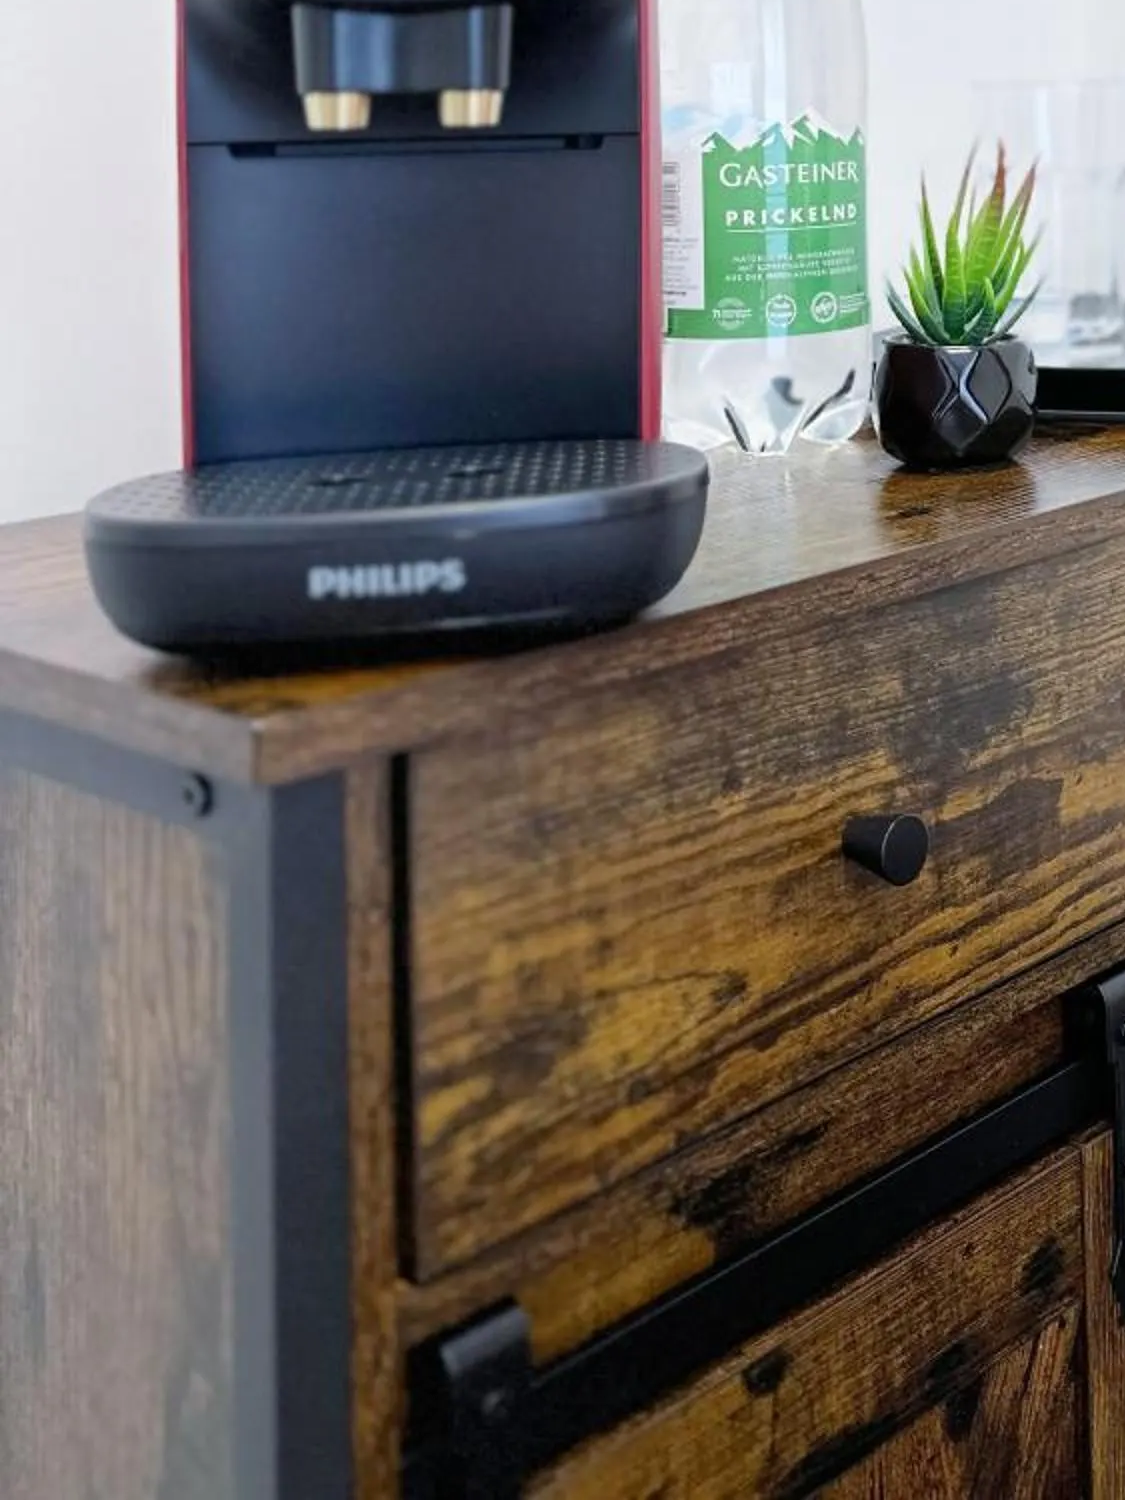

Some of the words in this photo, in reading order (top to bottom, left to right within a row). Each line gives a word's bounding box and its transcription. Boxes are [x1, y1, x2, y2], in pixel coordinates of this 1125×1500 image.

[719, 161, 860, 188] GASTEINER
[725, 203, 857, 226] PRICKELND
[308, 558, 466, 599] PHILIPS
